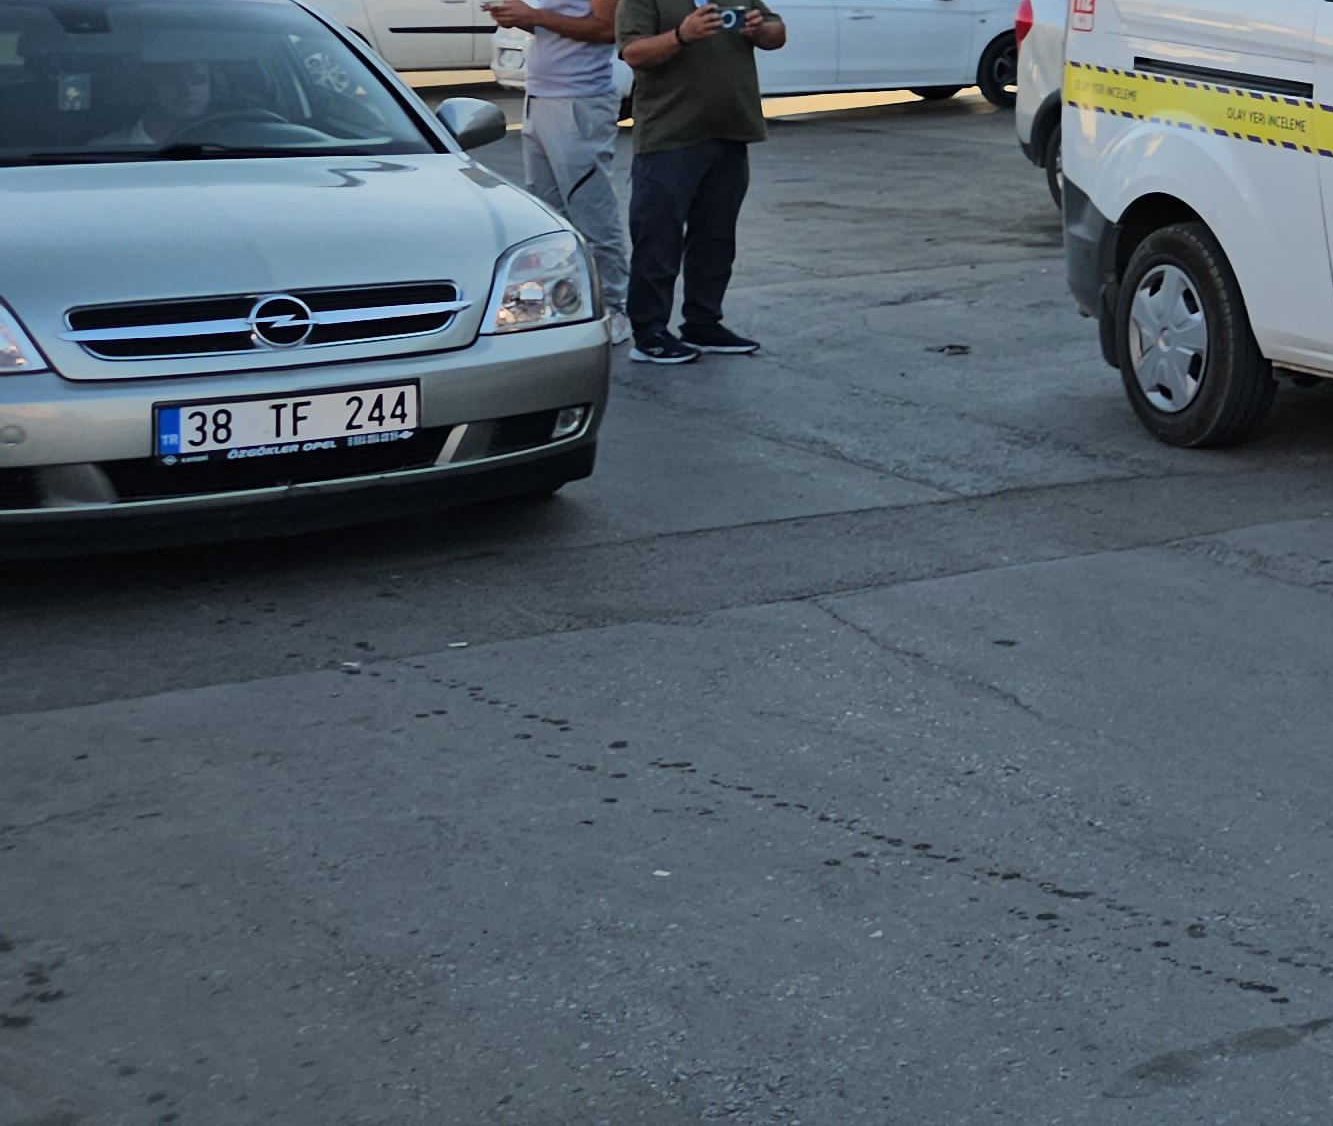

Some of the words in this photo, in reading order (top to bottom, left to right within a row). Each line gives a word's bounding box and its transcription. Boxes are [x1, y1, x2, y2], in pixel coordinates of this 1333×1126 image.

[1227, 107, 1246, 122] OLAY
[187, 409, 232, 447] 38
[270, 401, 312, 437] TF
[345, 391, 408, 430] 244
[161, 434, 179, 446] TR
[226, 442, 300, 460] ÖZGÖKLER
[303, 441, 337, 452] OPEL
